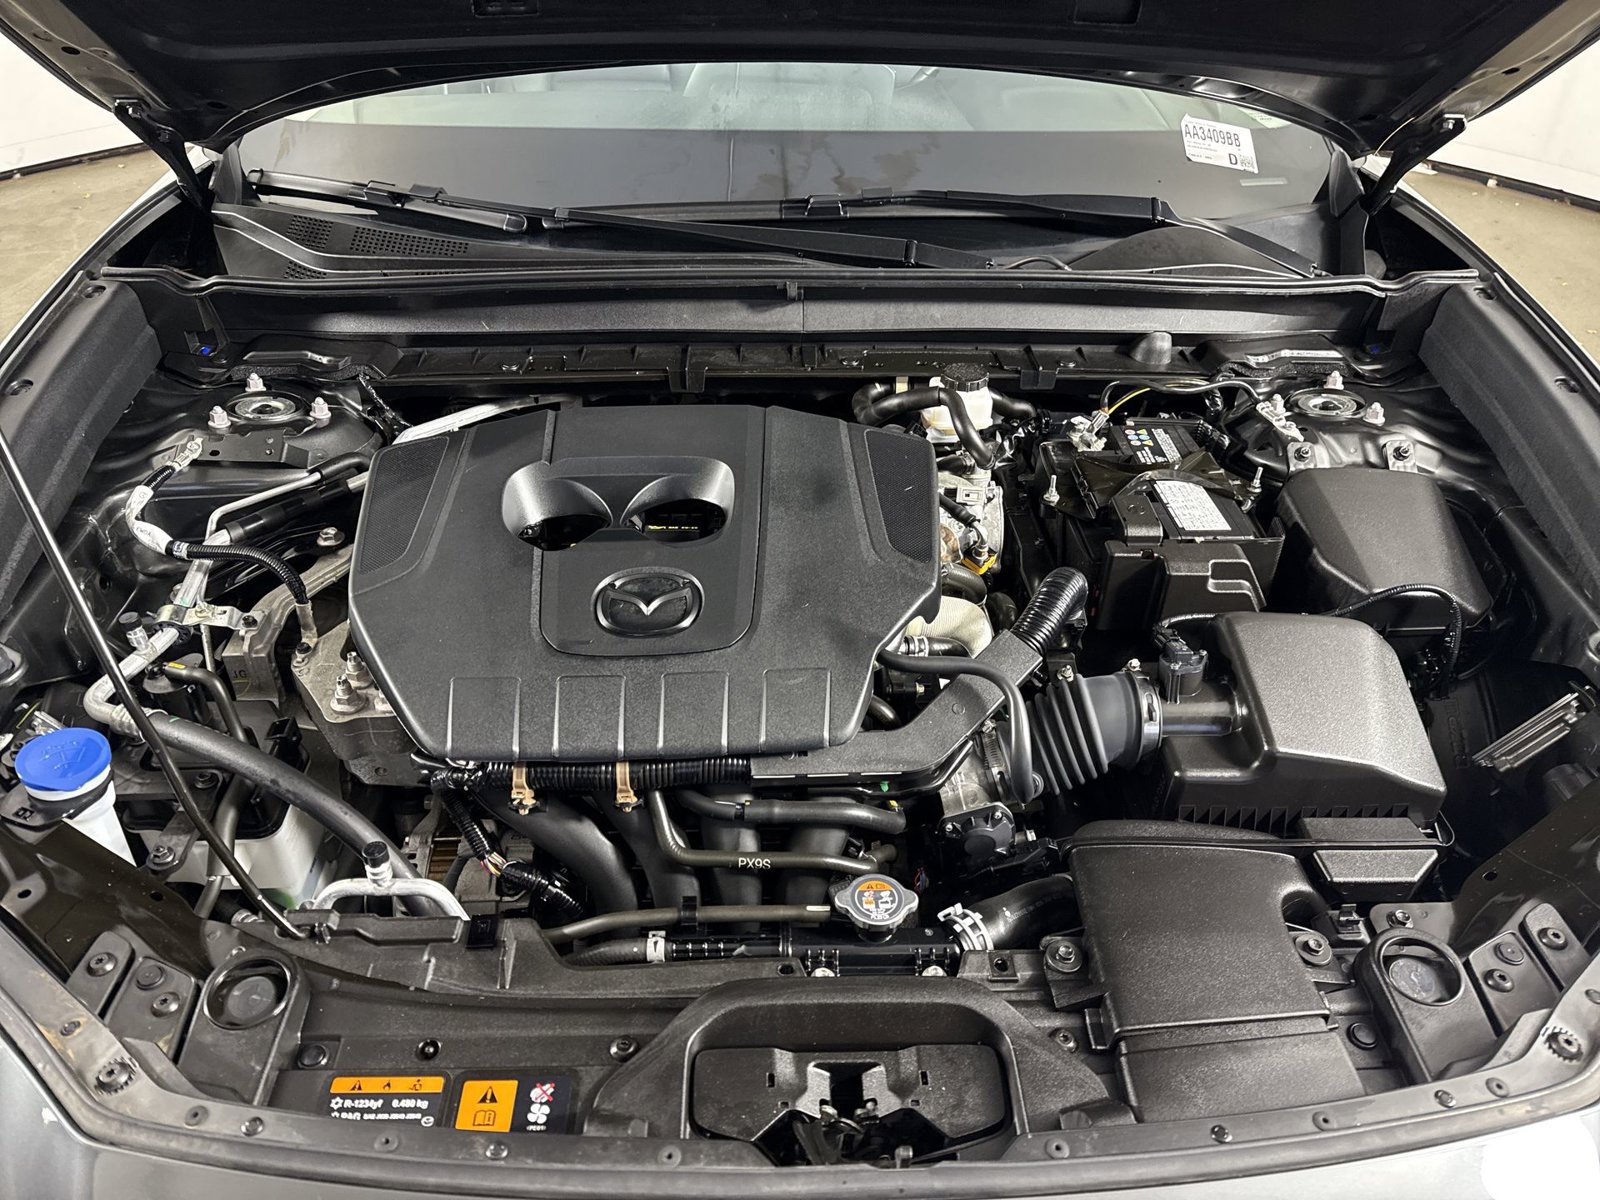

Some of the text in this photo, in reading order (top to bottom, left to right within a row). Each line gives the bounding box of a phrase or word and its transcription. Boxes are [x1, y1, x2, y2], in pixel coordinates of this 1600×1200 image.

[1184, 124, 1241, 147] AA3409BB
[1228, 153, 1238, 166] D
[738, 857, 771, 870] PX9S
[343, 1099, 384, 1110] R-1234yf
[416, 1100, 429, 1110] kg
